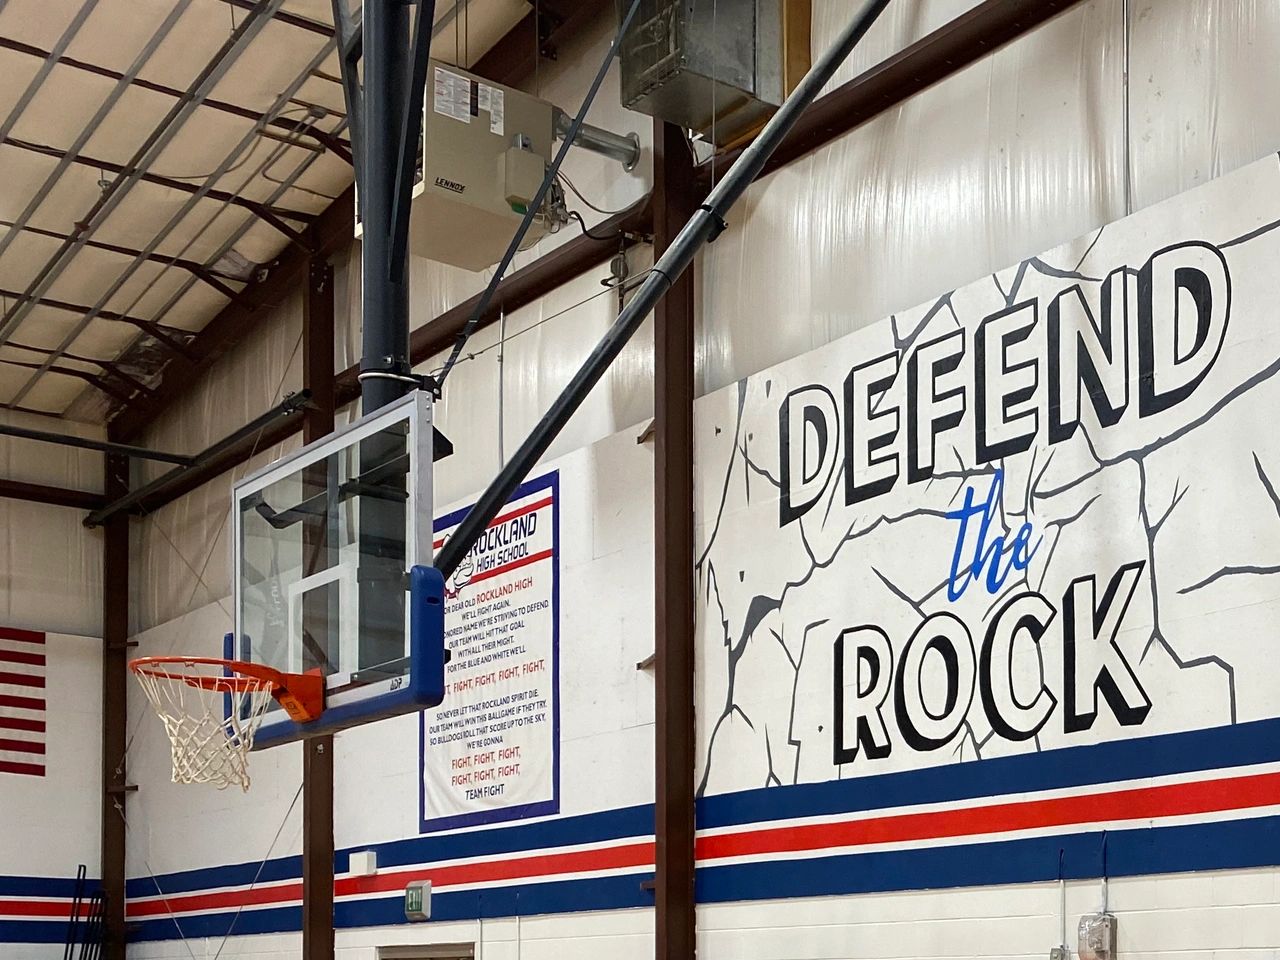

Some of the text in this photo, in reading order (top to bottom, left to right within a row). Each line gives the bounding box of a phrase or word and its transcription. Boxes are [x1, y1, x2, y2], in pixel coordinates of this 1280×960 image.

[434, 177, 465, 193] LENNOX
[779, 240, 1232, 527] DEFEND
[946, 468, 1043, 602] the
[476, 541, 528, 572] HIGH SCHOOL
[464, 598, 475, 608] OLD
[476, 583, 513, 605] ROCKLAND
[514, 576, 533, 591] HIGH
[463, 621, 477, 632] NAME
[493, 609, 518, 623] STRIVING
[518, 606, 526, 615] TO
[477, 604, 492, 616] FIGHT
[448, 620, 525, 649] OUR TEAM WILL HIT THAT GOAL
[458, 648, 471, 658] WITH
[471, 645, 481, 655] ALL
[481, 640, 496, 652] THEIR
[447, 663, 457, 673] FOR
[457, 660, 467, 671] THE
[467, 657, 480, 668] BLUE
[479, 654, 492, 665] AND
[492, 649, 509, 660] WHITE
[833, 560, 1153, 765] ROCK
[429, 724, 440, 734] OUR
[440, 721, 453, 732] TEAM
[454, 718, 464, 729] WILL
[464, 716, 476, 726] WIN
[475, 713, 487, 724] THIS
[515, 705, 521, 714] IF
[522, 702, 536, 713] THEY
[436, 712, 443, 721] SO
[443, 708, 459, 719] NEVER
[460, 705, 468, 716] LET
[468, 703, 481, 715] THAT
[482, 695, 510, 712] ROCKLAND
[511, 691, 528, 703] SPIRIT
[429, 737, 437, 746] SO
[437, 731, 463, 745] BULLDOGS
[462, 729, 476, 740] ROLL
[476, 725, 489, 737] THAT
[489, 721, 507, 733] SCORE
[507, 719, 515, 729] UP
[514, 717, 523, 727] TO
[523, 715, 535, 726] THE
[483, 735, 503, 747] GONNA
[465, 783, 505, 800] TEAM FIGHT
